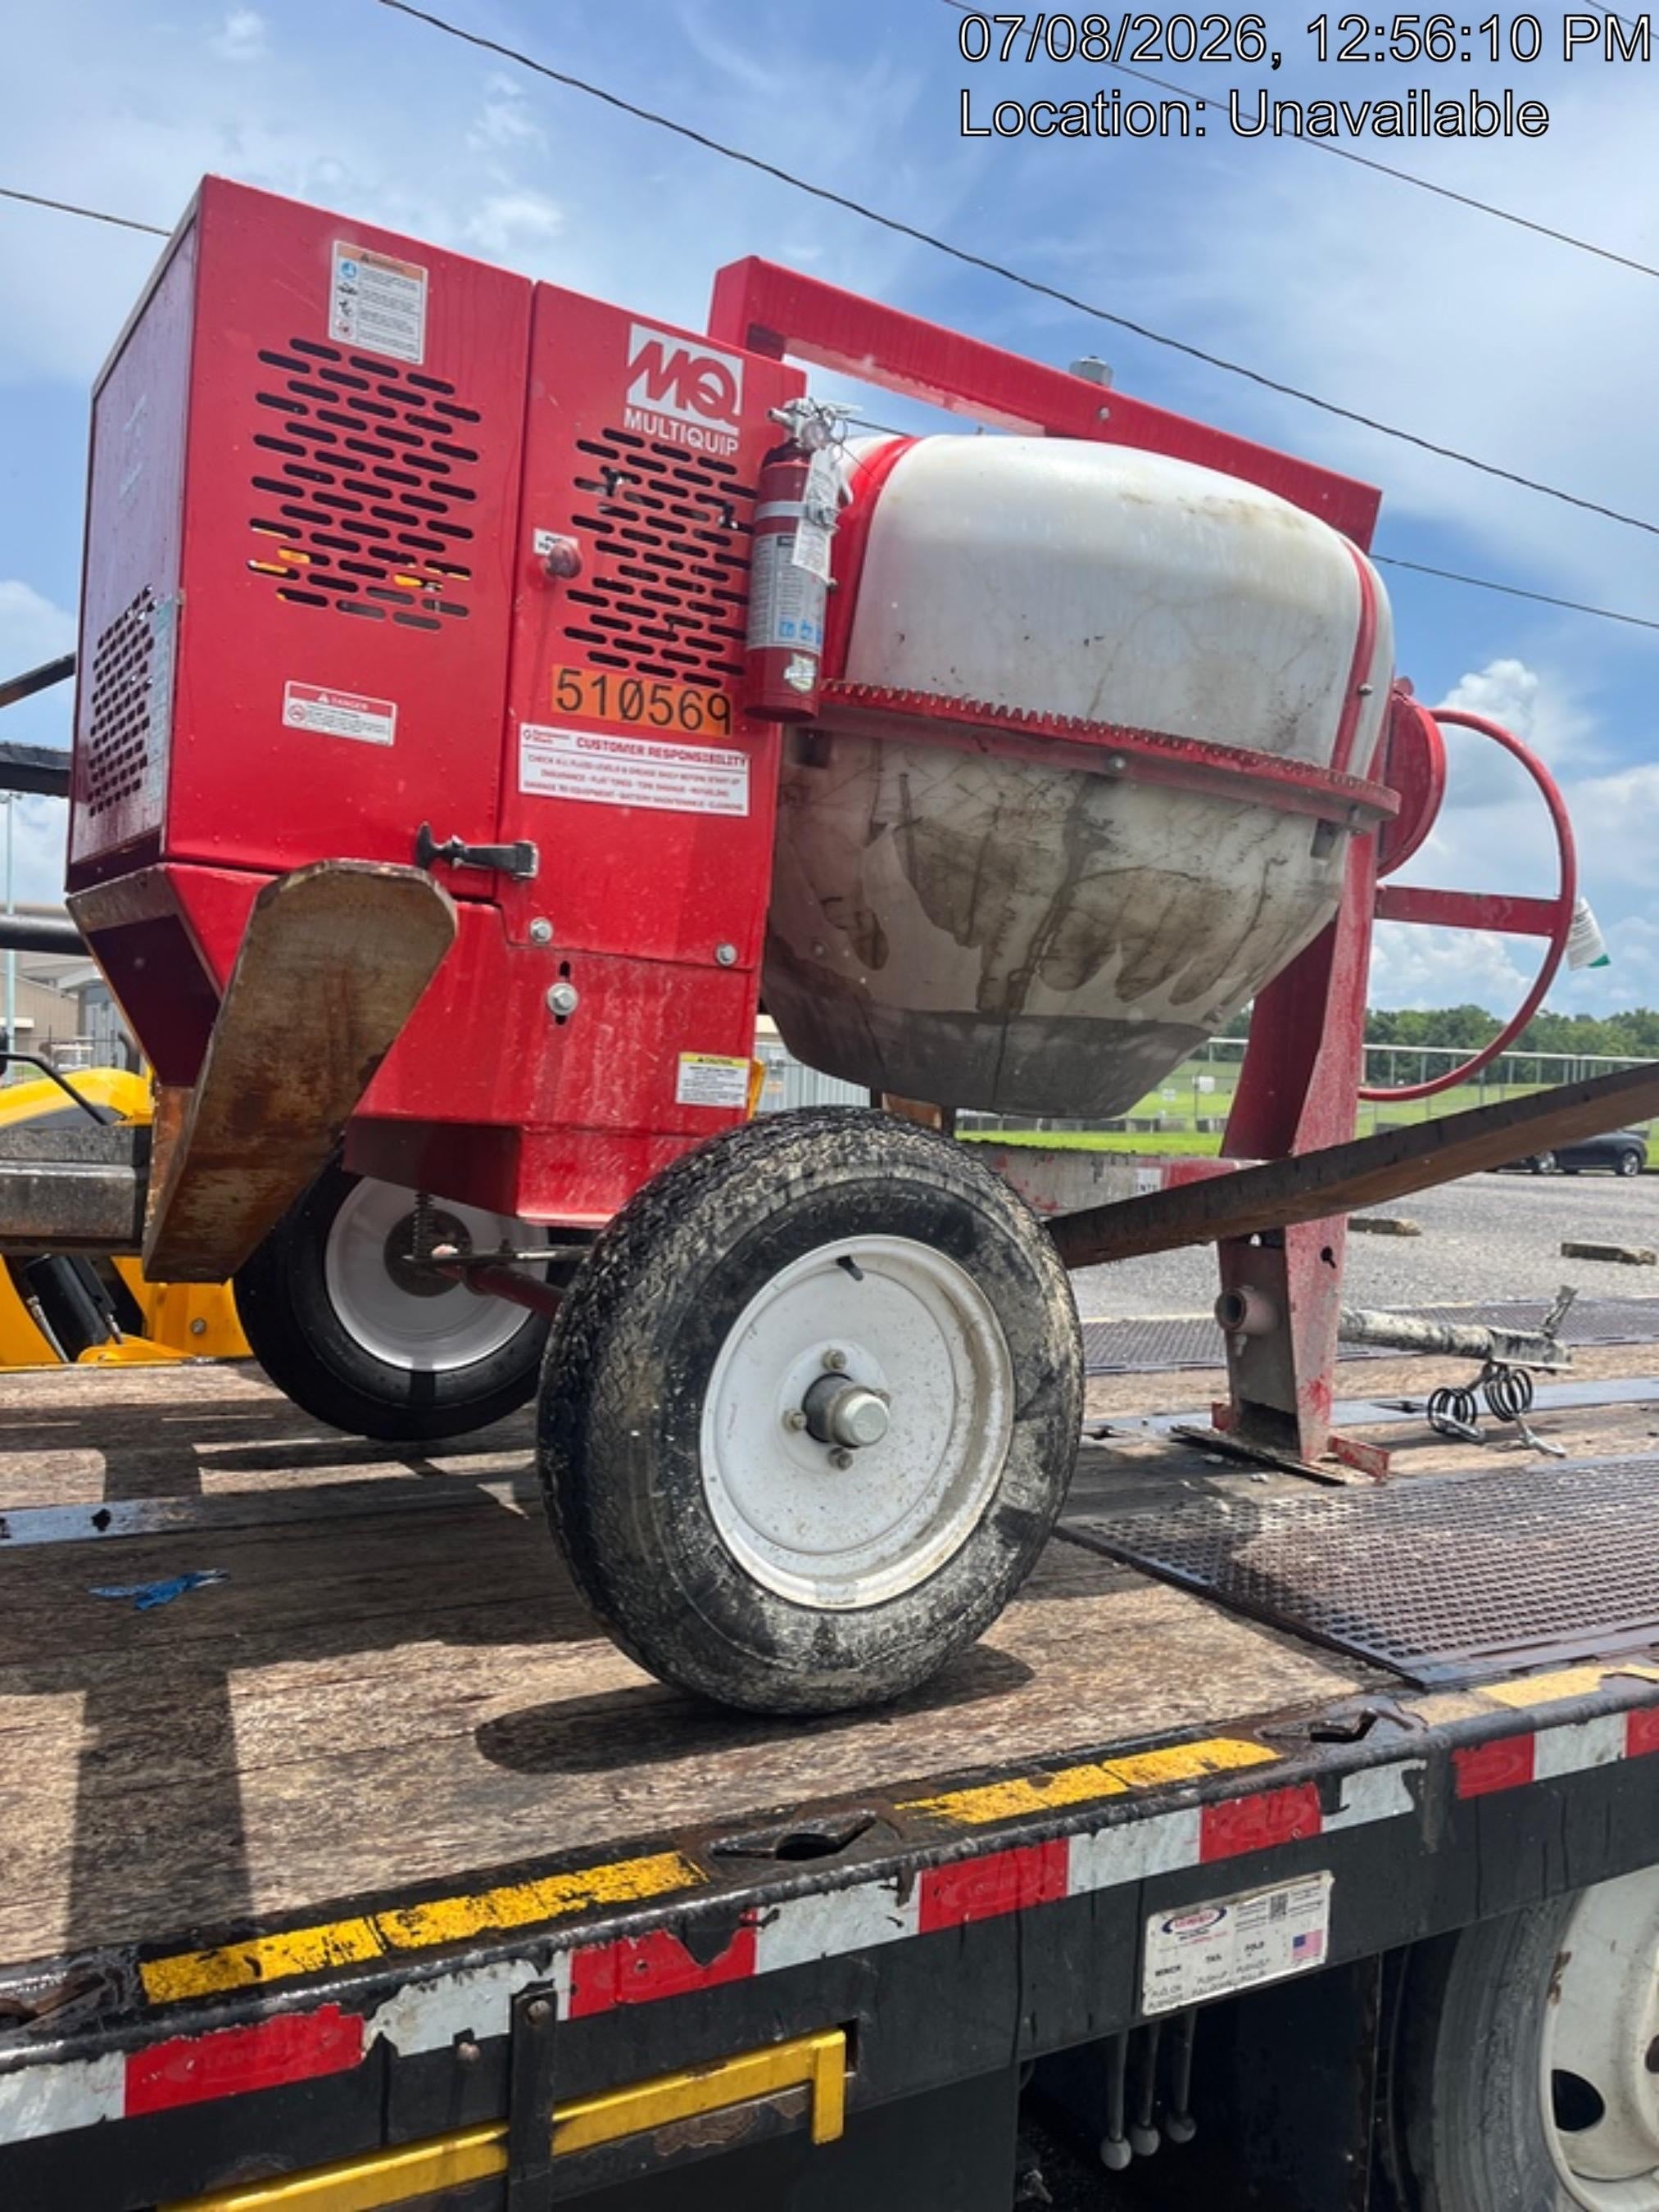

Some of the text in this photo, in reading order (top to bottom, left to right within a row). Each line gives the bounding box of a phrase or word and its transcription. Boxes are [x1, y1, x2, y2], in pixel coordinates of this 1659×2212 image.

[627, 334, 742, 432] MQ
[623, 407, 739, 457] MULTIQUIP
[555, 667, 732, 736] 510569
[577, 736, 646, 755] CUSTOMER
[648, 746, 746, 768] RESPONSIBILITY
